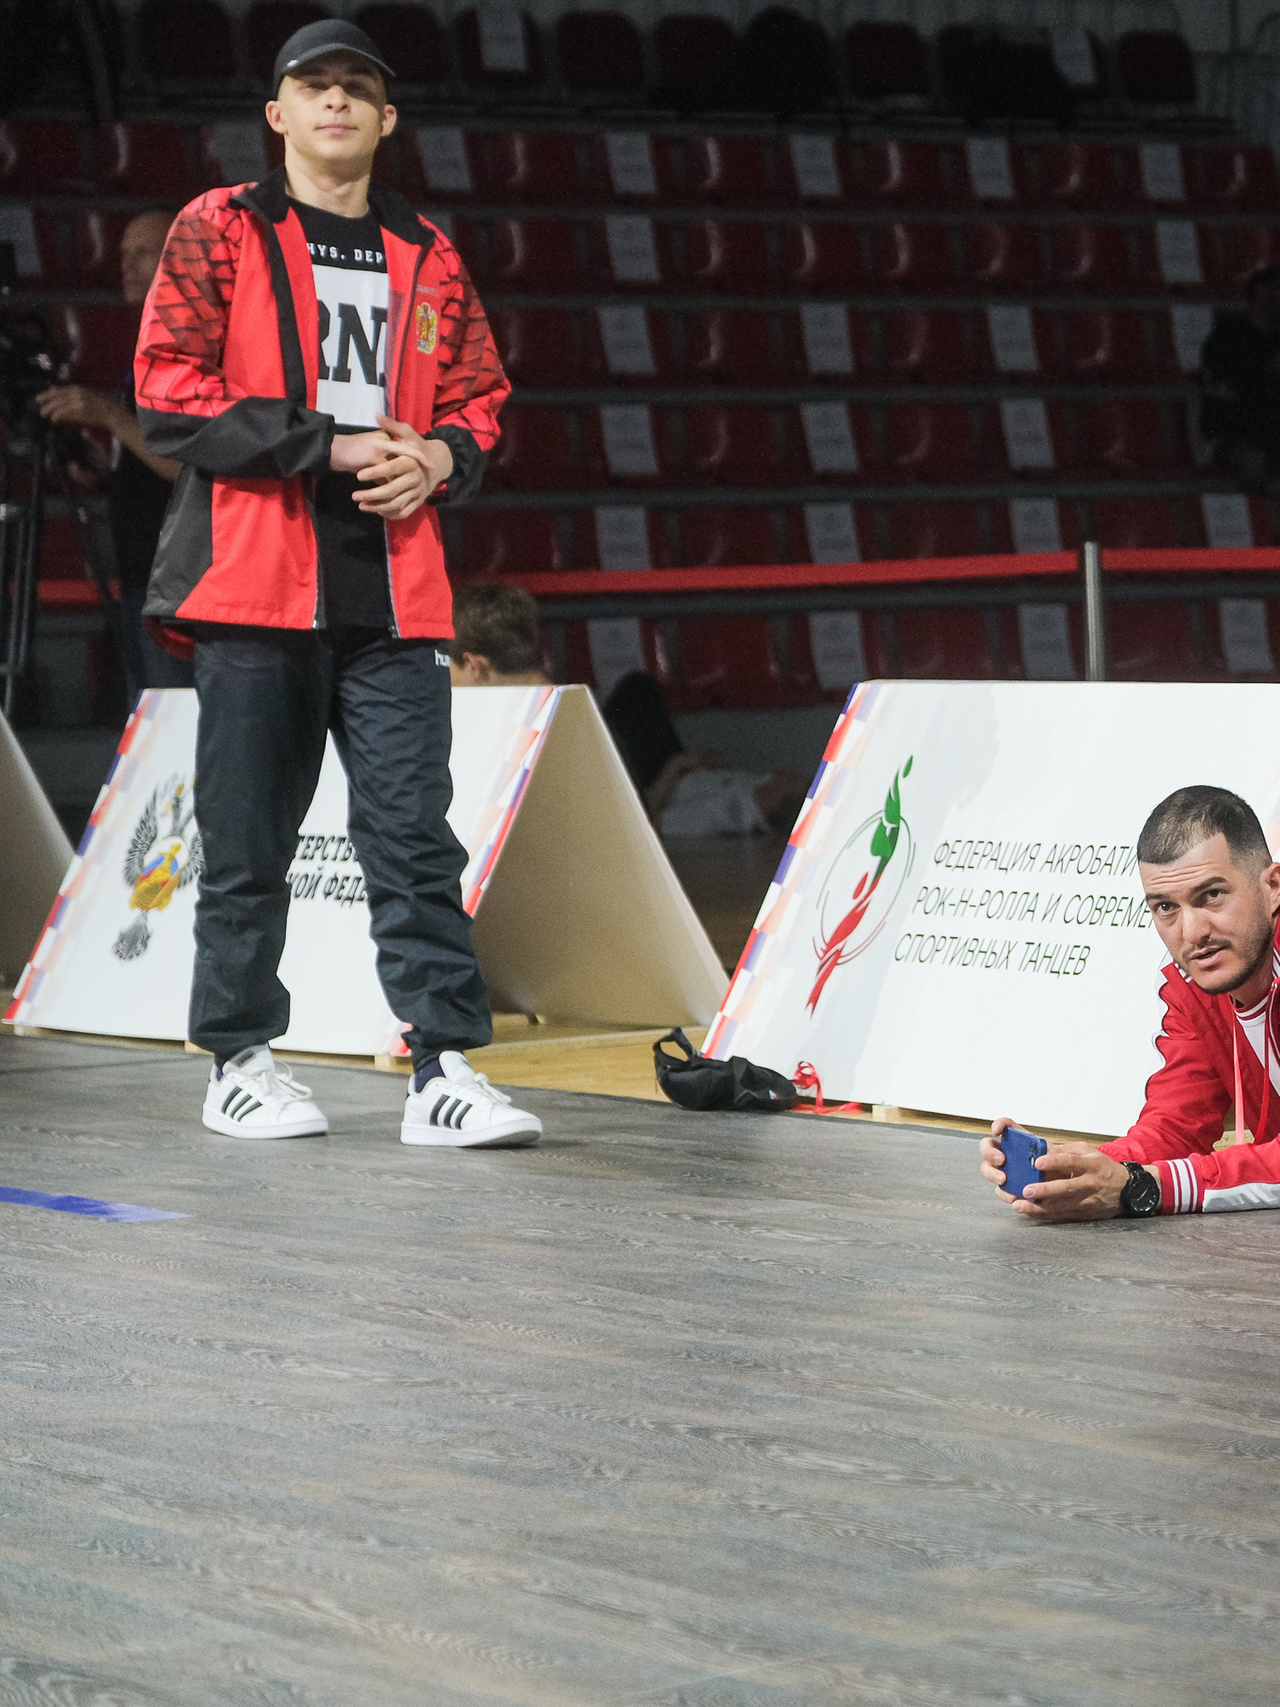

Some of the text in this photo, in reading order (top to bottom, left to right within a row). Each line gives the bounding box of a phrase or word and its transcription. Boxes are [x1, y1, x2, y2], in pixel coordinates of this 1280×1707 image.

[933, 839, 1042, 875] ФЕДЕРАЦИЯ
[911, 885, 1039, 922] РОК-Н-РОЛЛА
[1041, 892, 1063, 923] И
[894, 933, 1091, 979] СПОРТИВНЫХ ТАНЦЕВ
